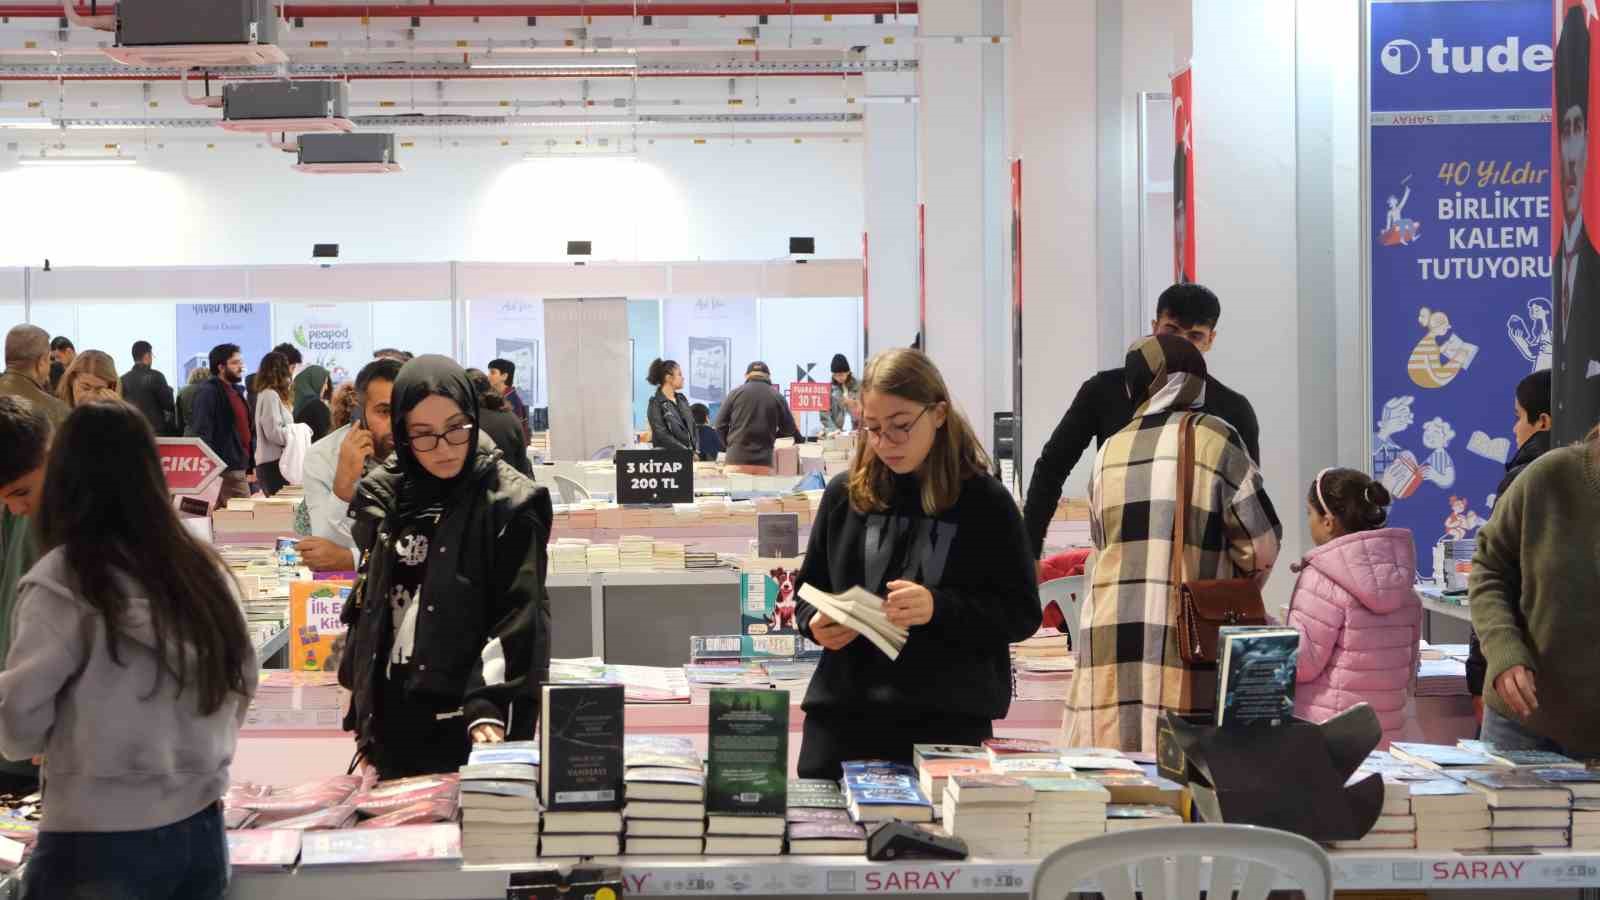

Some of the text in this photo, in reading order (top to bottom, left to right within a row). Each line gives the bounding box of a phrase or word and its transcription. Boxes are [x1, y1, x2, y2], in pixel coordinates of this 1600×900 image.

[1427, 36, 1553, 74] tude
[1437, 160, 1471, 186] 40
[1437, 190, 1550, 220] BİRLİKTE
[1448, 225, 1539, 250] KALEM
[1416, 255, 1553, 281] TUTUYORU
[308, 327, 349, 341] peapod
[308, 340, 353, 350] readers
[798, 394, 824, 408] 30 TL
[626, 459, 683, 474] 3 KİTAP
[631, 478, 679, 489] 200 TL
[310, 600, 330, 615] İlk
[864, 870, 957, 892] SARAY
[1431, 860, 1526, 881] SARAY
